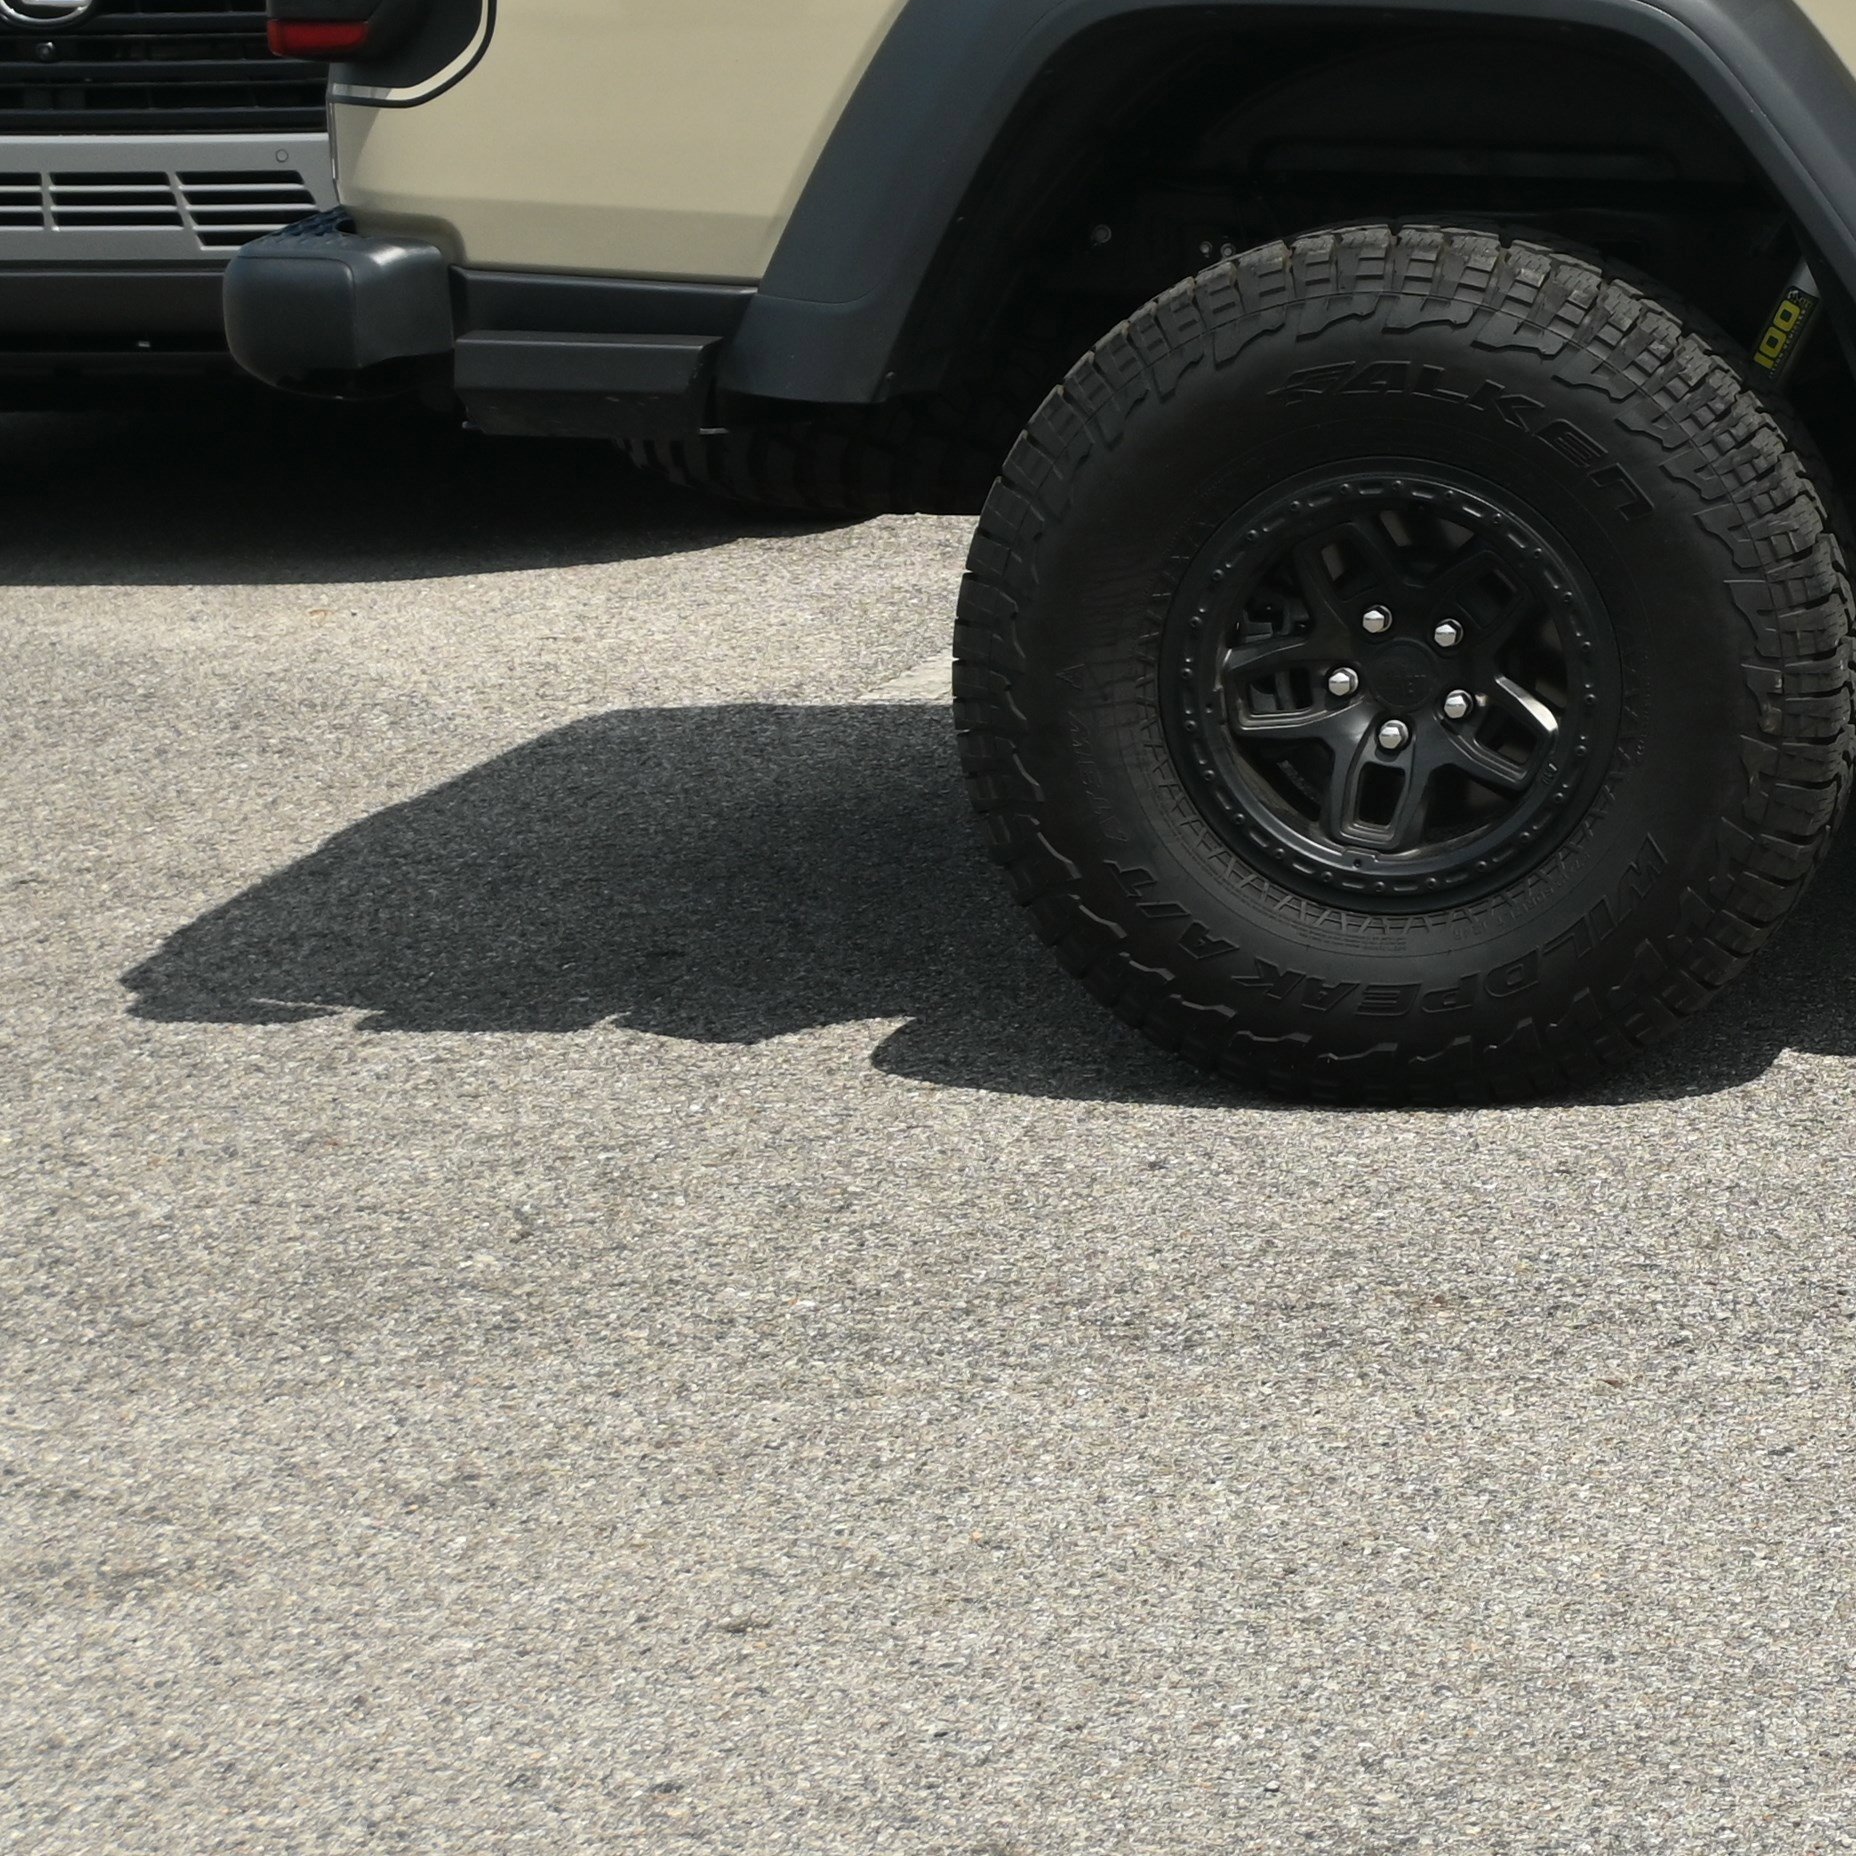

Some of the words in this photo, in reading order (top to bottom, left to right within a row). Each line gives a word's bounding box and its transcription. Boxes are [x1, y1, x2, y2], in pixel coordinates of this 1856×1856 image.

[1266, 360, 1655, 522] FALKEN
[1103, 859, 1240, 960] A/T
[1231, 832, 1668, 1017] WILDPEAK
